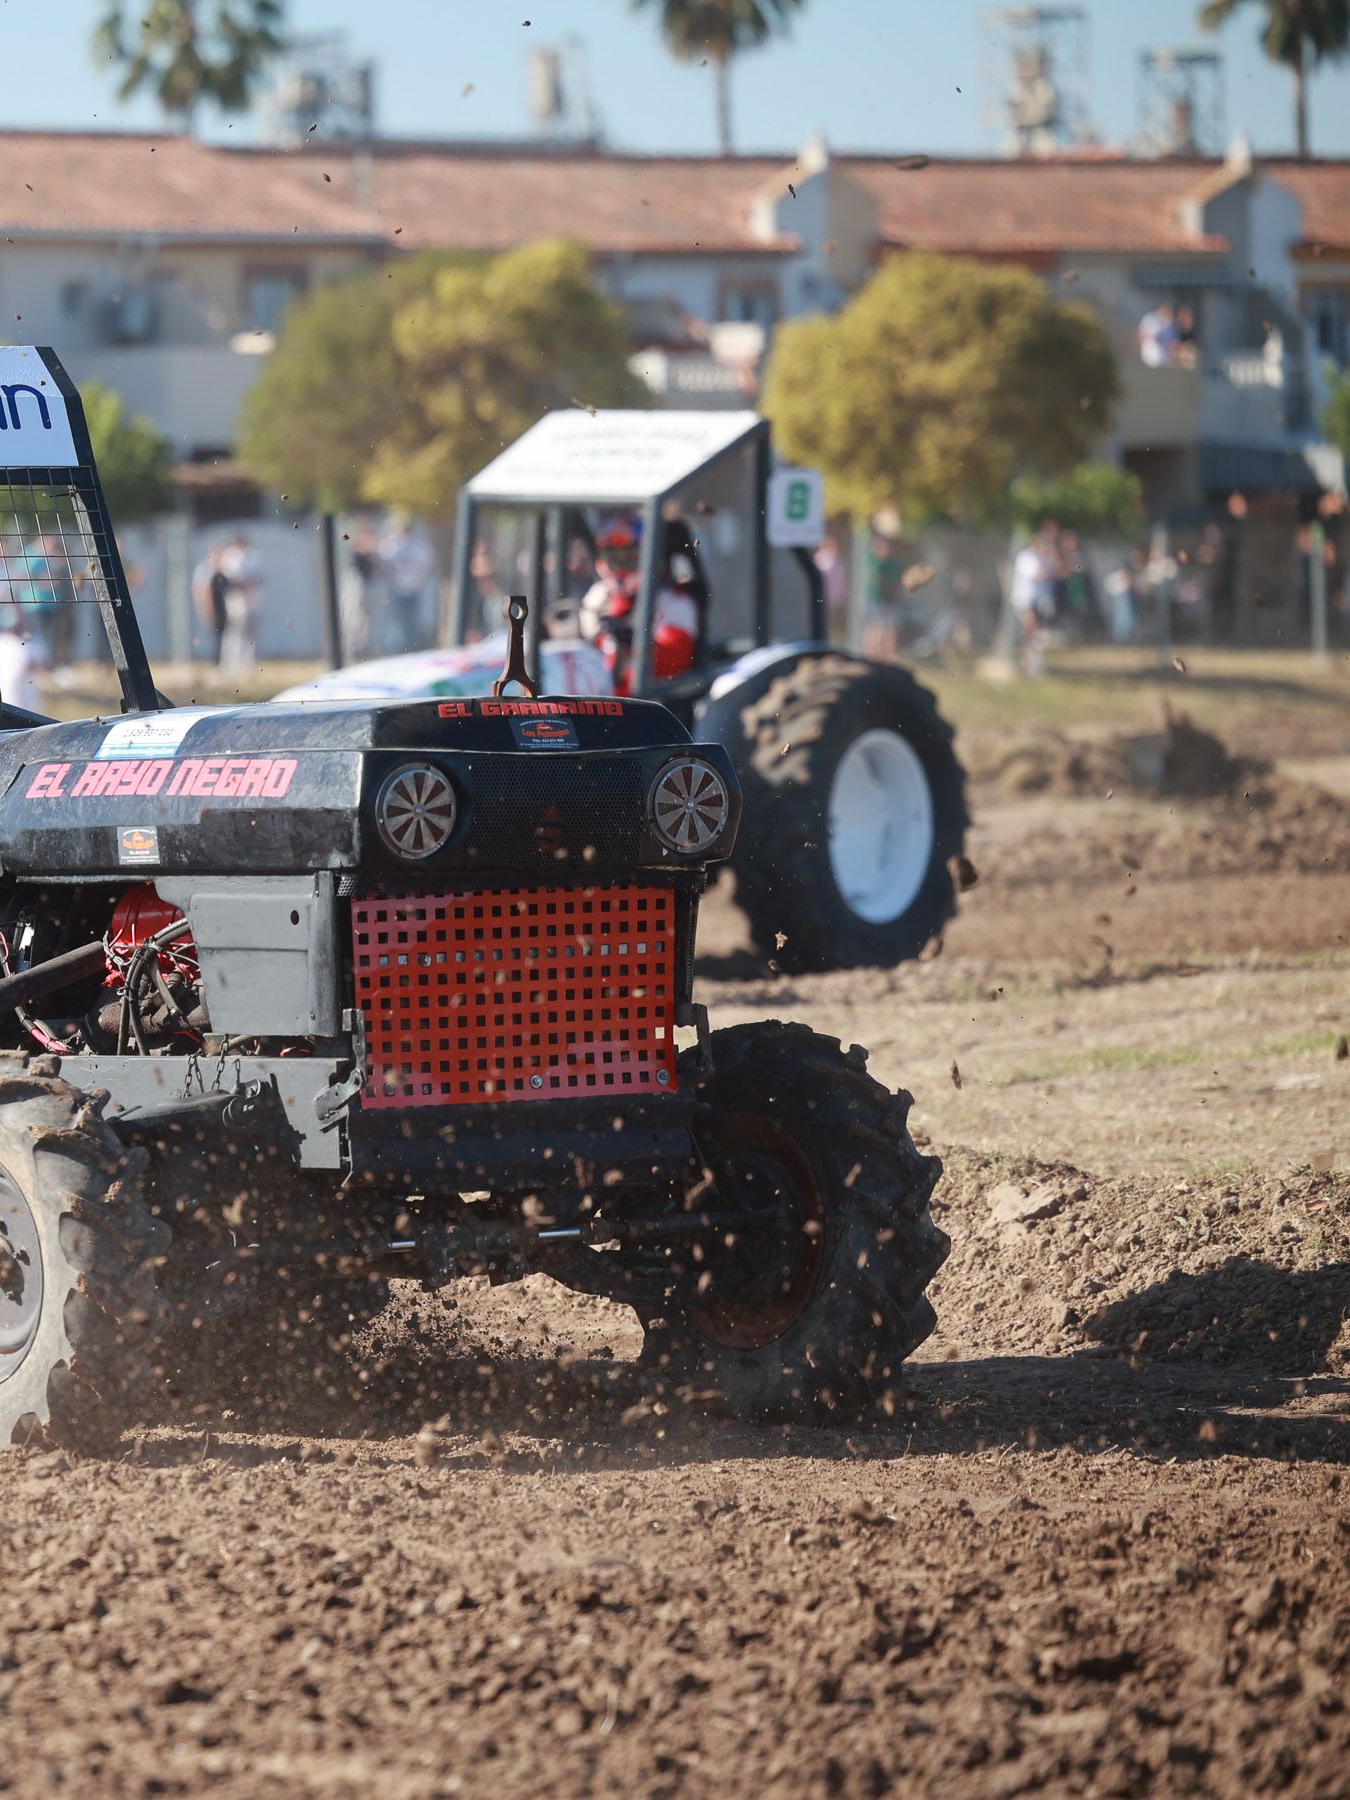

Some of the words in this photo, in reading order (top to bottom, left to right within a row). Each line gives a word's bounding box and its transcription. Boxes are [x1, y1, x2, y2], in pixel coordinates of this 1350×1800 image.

[437, 703, 474, 718] EL
[25, 763, 73, 799] EL
[70, 760, 174, 797] RAYO
[166, 759, 298, 798] NEGRO
